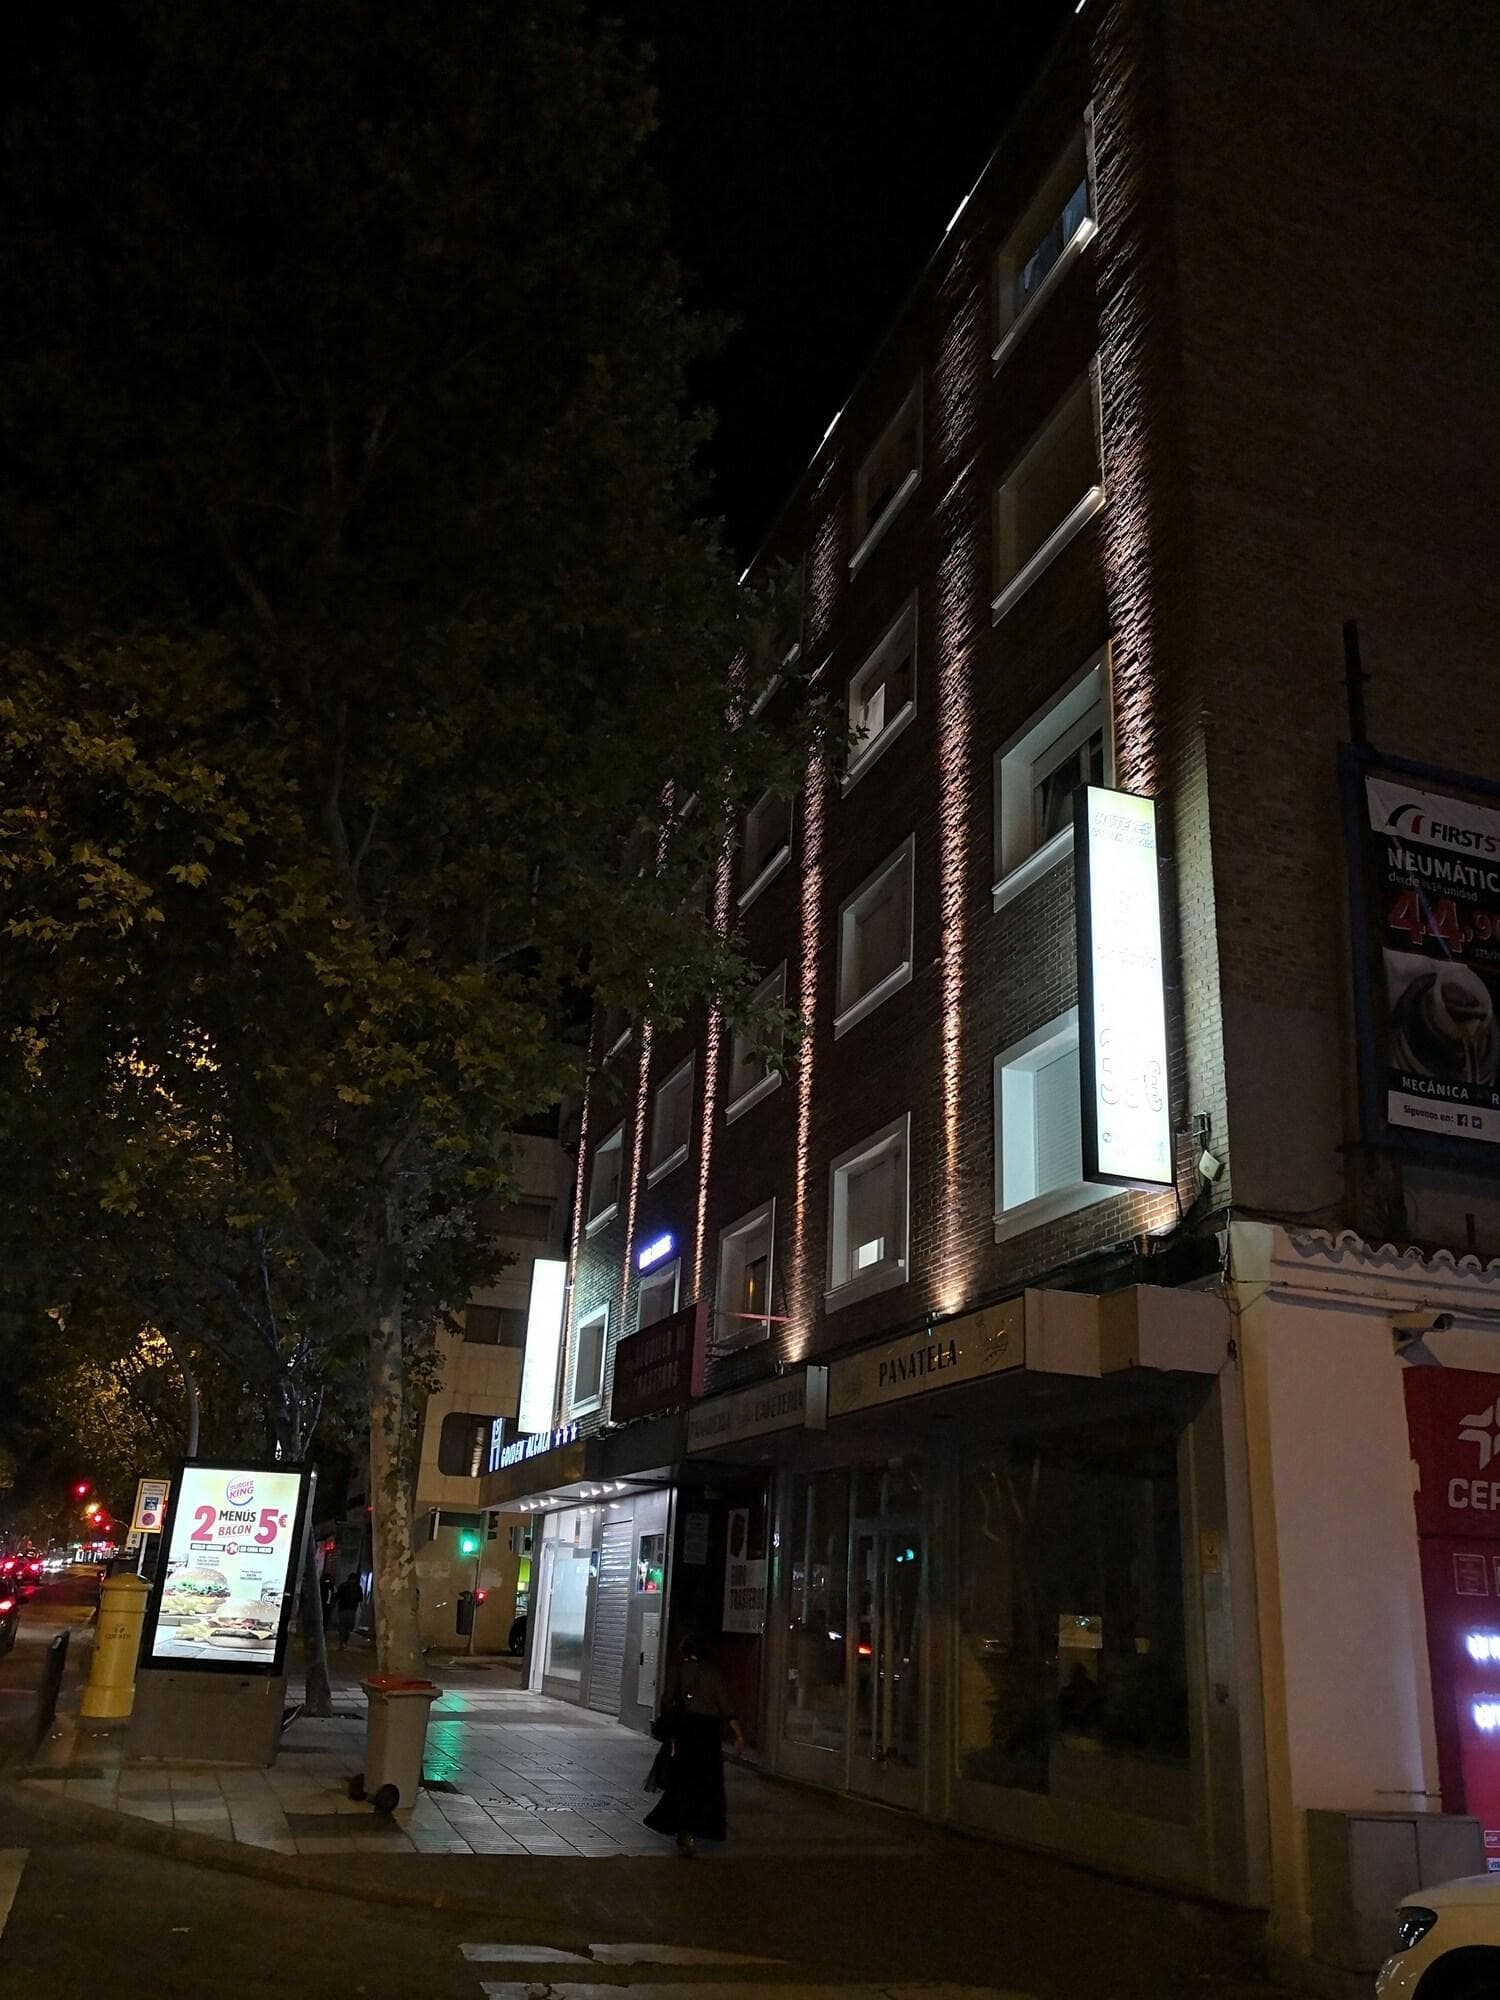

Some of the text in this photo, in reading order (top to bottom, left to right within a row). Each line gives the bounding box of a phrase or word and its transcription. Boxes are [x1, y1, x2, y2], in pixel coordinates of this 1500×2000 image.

[1443, 886, 1478, 902] unidad
[1402, 1076, 1469, 1100] MECÁNICA
[879, 1339, 957, 1387] PANATELA
[229, 1486, 254, 1499] KING
[190, 1505, 217, 1542] 2
[219, 1509, 256, 1523] MENÚS
[218, 1525, 252, 1536] BACON
